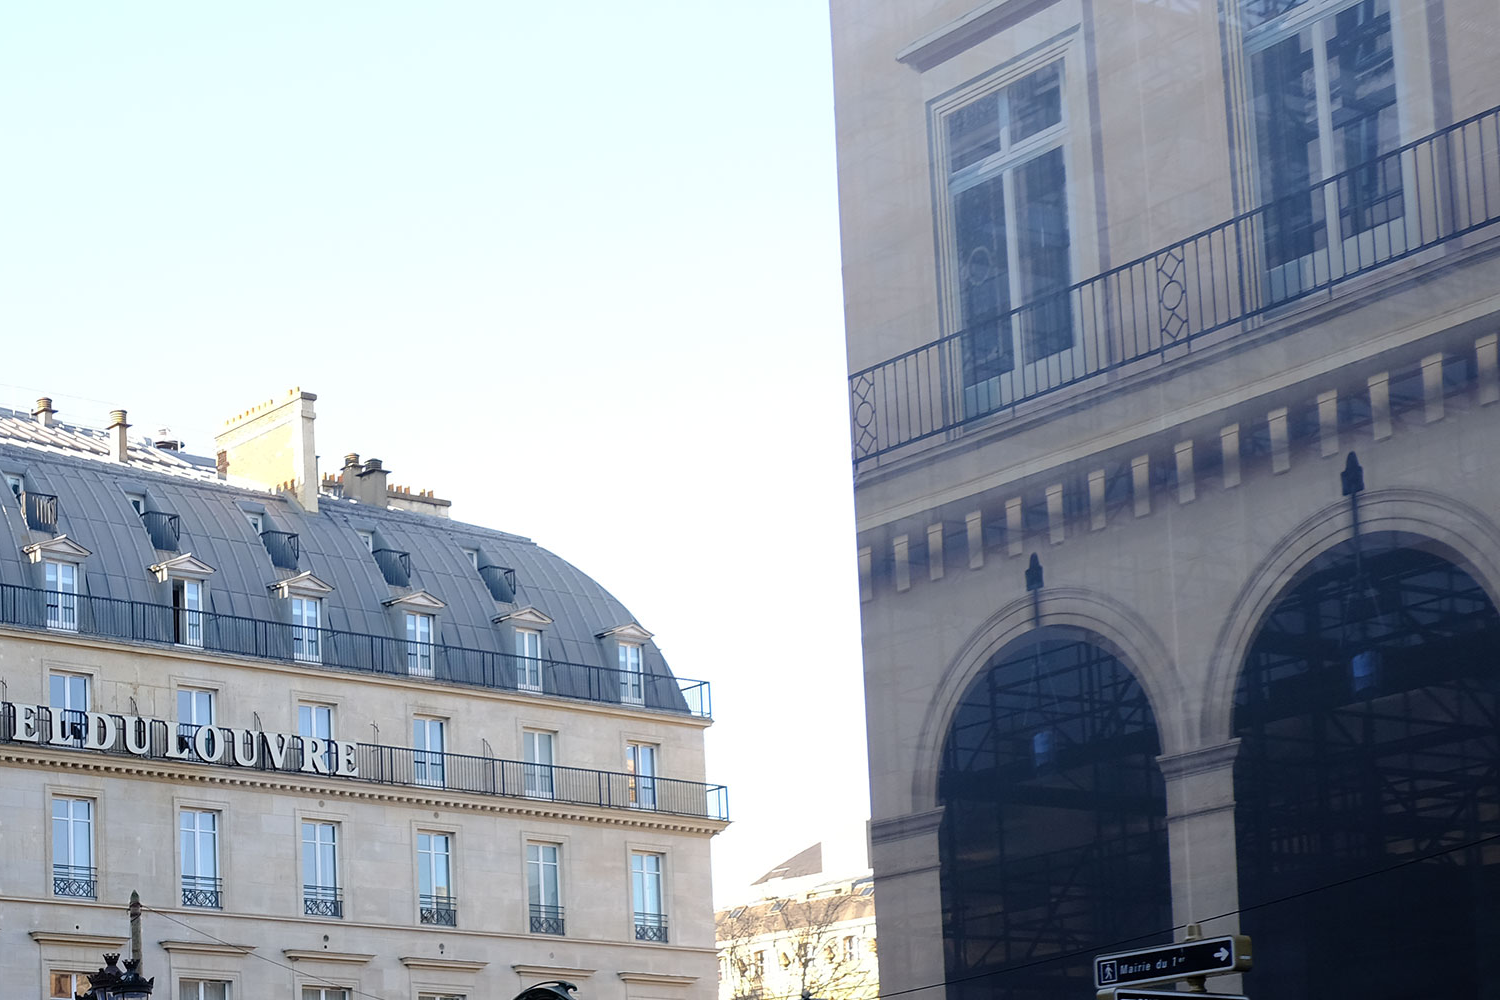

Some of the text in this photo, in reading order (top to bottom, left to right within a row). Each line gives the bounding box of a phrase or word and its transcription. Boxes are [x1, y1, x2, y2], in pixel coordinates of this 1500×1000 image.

[83, 711, 152, 756] DU
[163, 721, 360, 778] LOUVRE
[1120, 961, 1151, 974] Mairie
[1156, 959, 1167, 969] du
